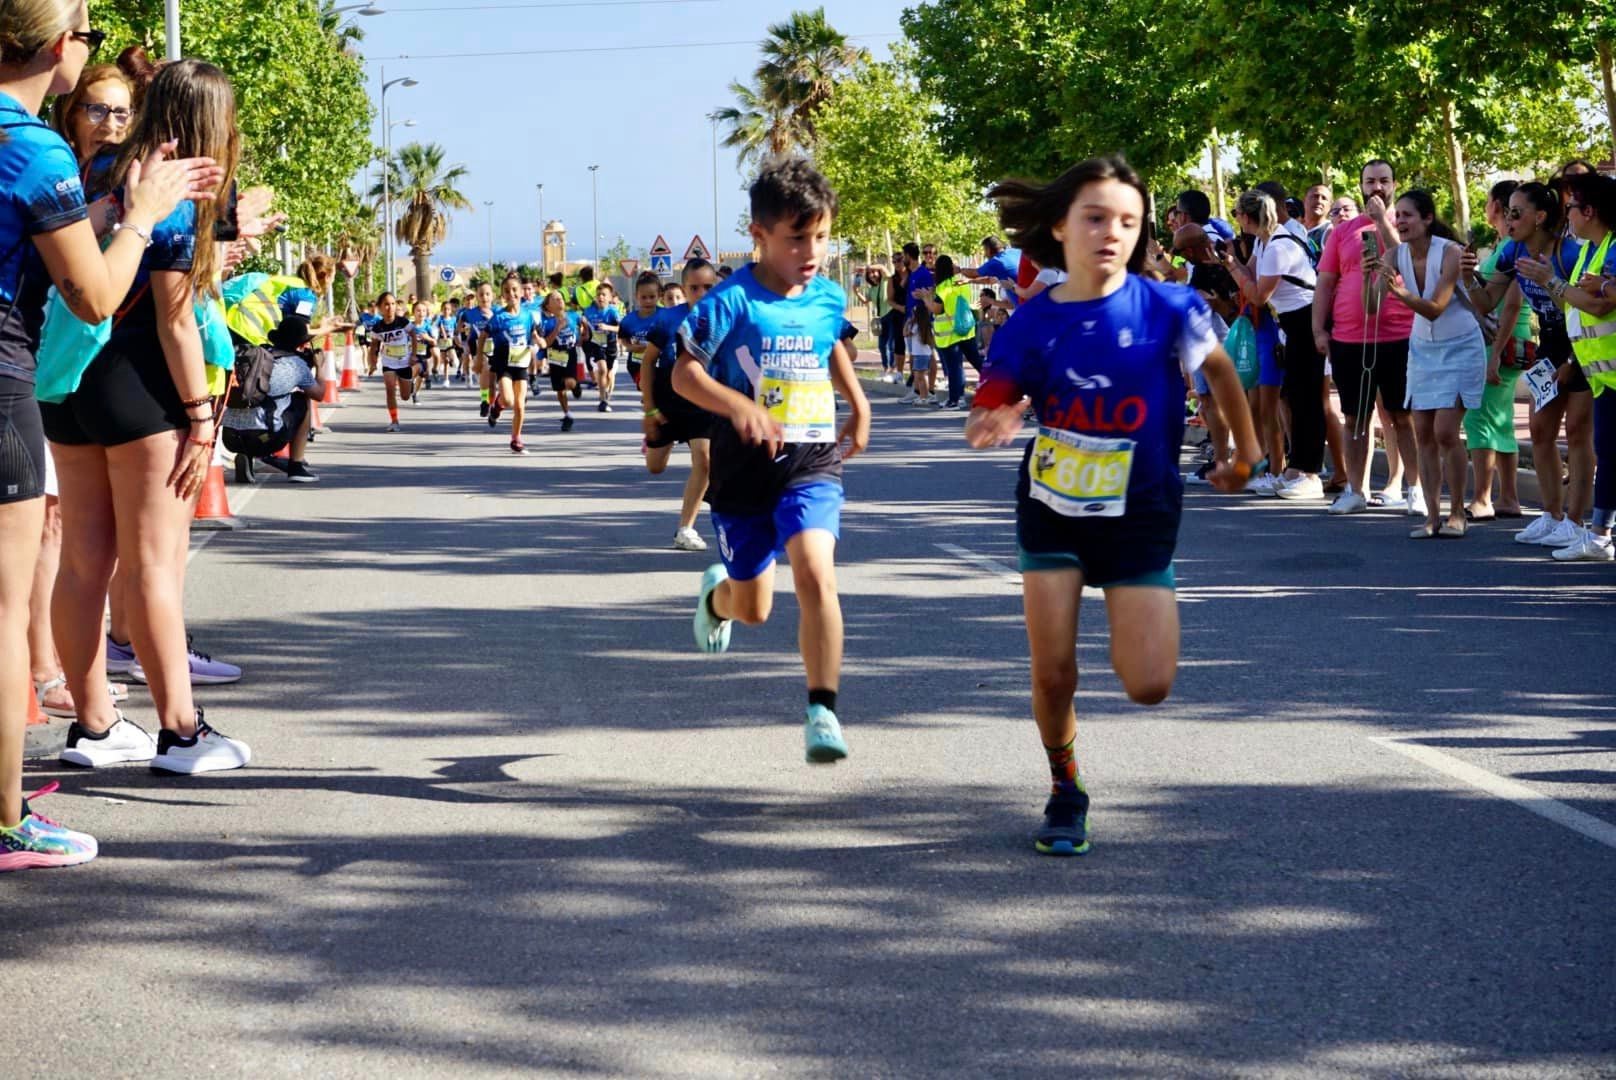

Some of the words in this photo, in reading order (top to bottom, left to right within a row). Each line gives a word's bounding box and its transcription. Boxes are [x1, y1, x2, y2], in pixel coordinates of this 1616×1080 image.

[775, 335, 814, 351] ROAD
[1042, 395, 1148, 433] GALO
[1057, 456, 1125, 494] 609
